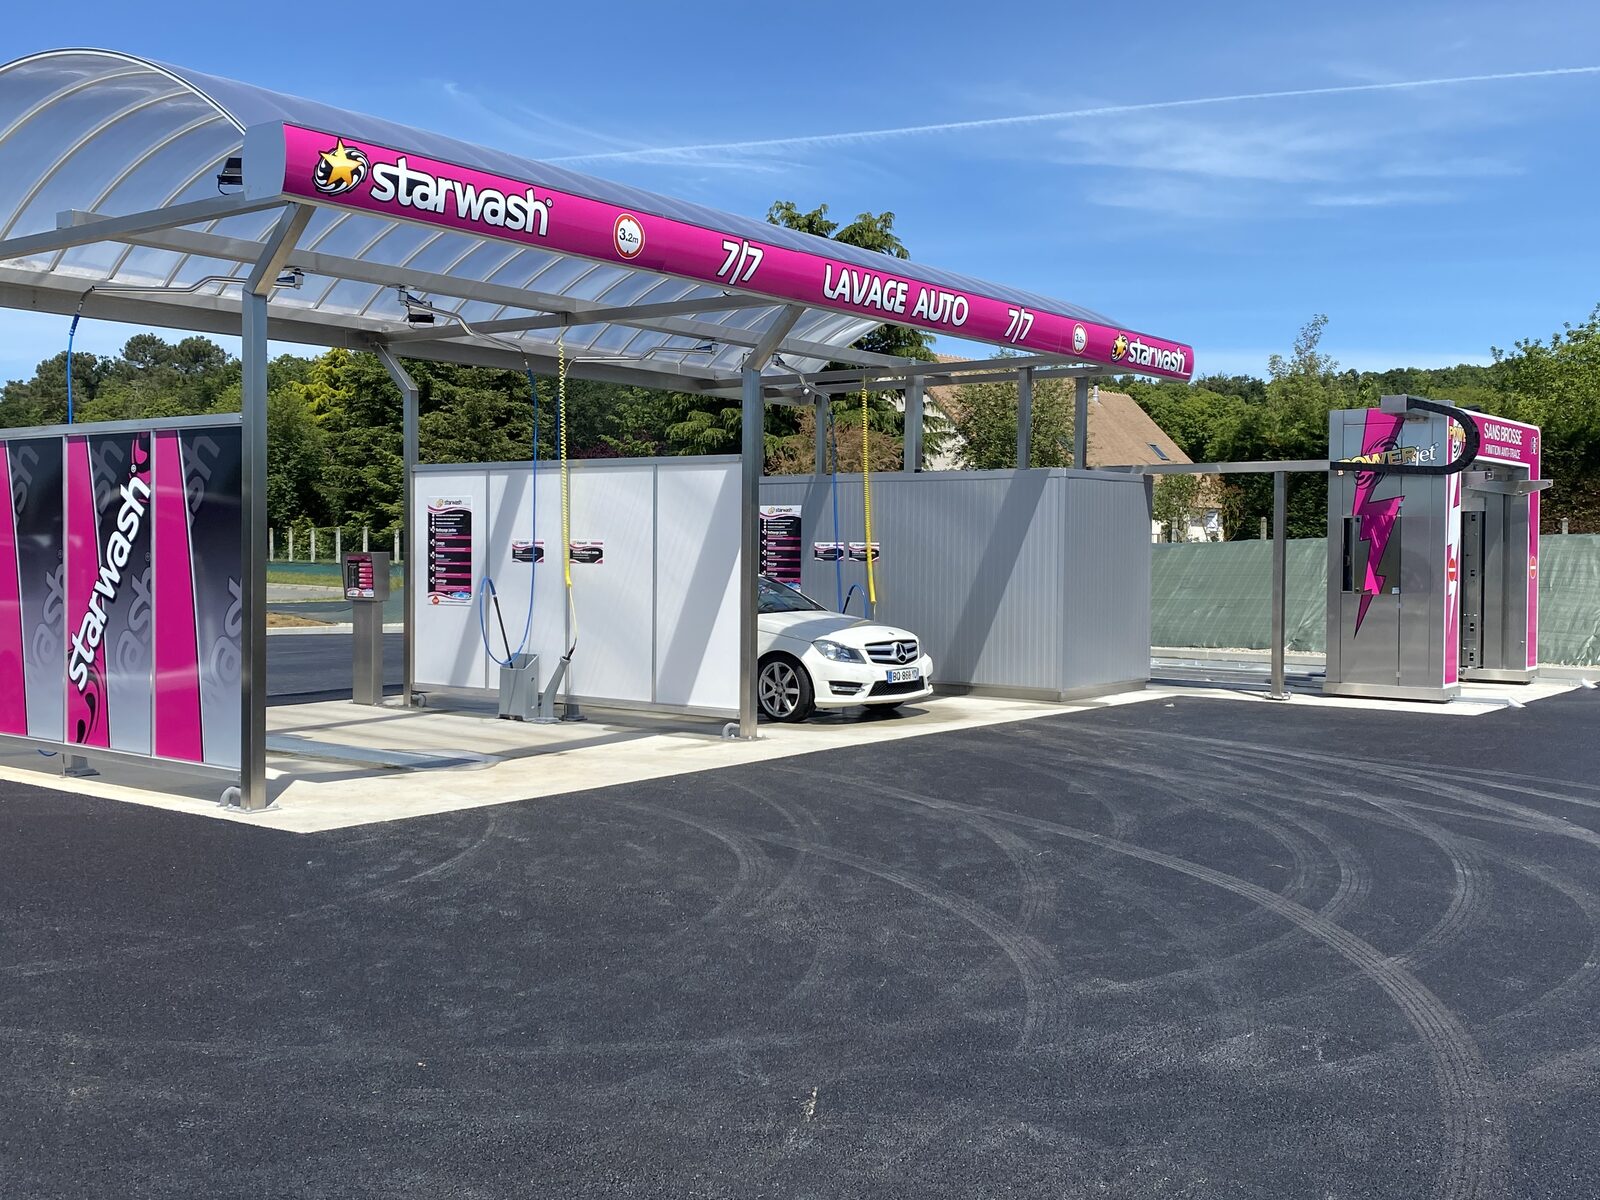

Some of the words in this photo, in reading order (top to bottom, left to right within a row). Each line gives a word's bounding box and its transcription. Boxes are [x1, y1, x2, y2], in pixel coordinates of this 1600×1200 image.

[619, 227, 639, 244] 3.2m
[823, 263, 909, 315] LAVAGE
[912, 287, 969, 327] AUTO
[1127, 337, 1186, 373] starwash
[1484, 422, 1501, 440] SANS
[1501, 427, 1523, 445] BROSSE
[68, 474, 152, 691] starwash
